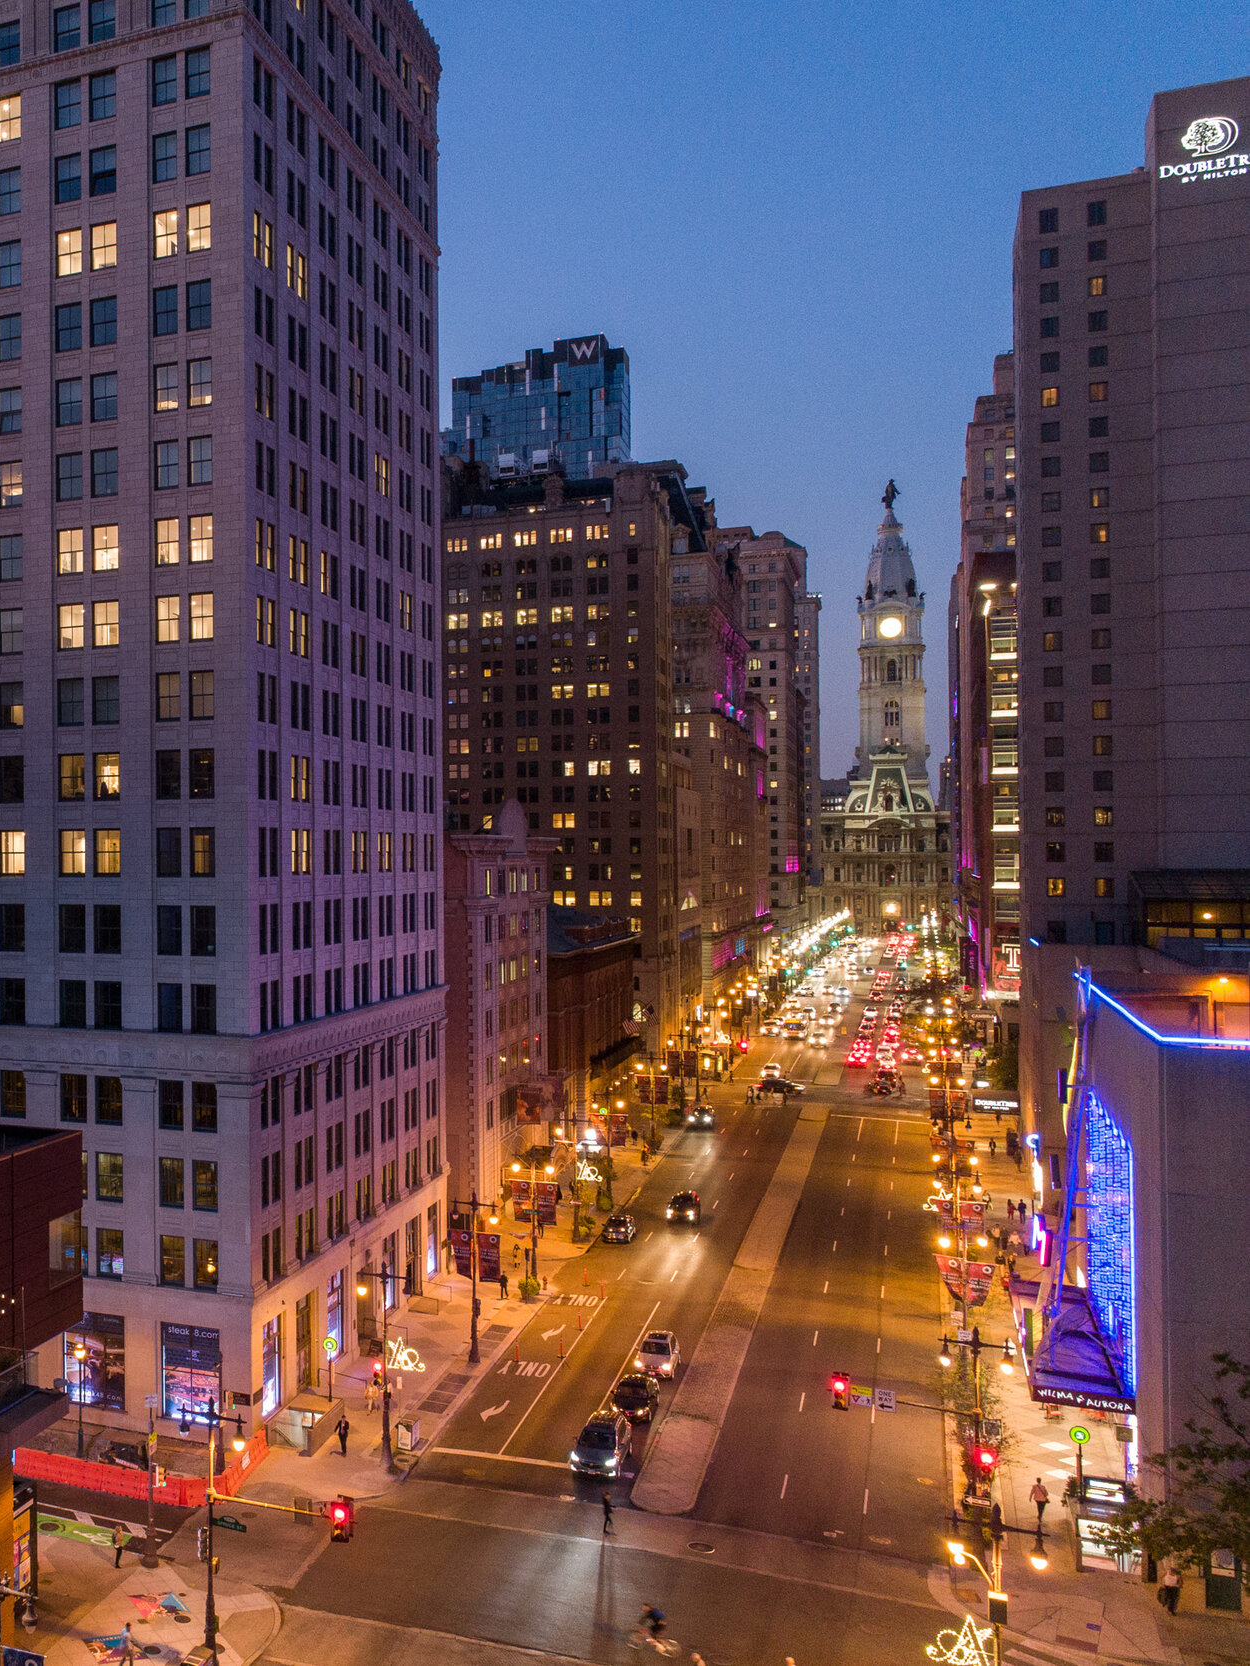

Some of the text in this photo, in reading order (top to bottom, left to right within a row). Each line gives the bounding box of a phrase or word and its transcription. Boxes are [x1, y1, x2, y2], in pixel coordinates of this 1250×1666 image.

[1159, 154, 1250, 178] DOUBLETR
[1181, 168, 1248, 184] BY HILTON
[570, 340, 596, 360] W
[552, 1293, 599, 1307] ONLY
[167, 1325, 219, 1339] steak8.com
[497, 1360, 551, 1378] ONLY
[878, 1390, 892, 1398] ONE
[1037, 1388, 1133, 1411] WILMA AURORA
